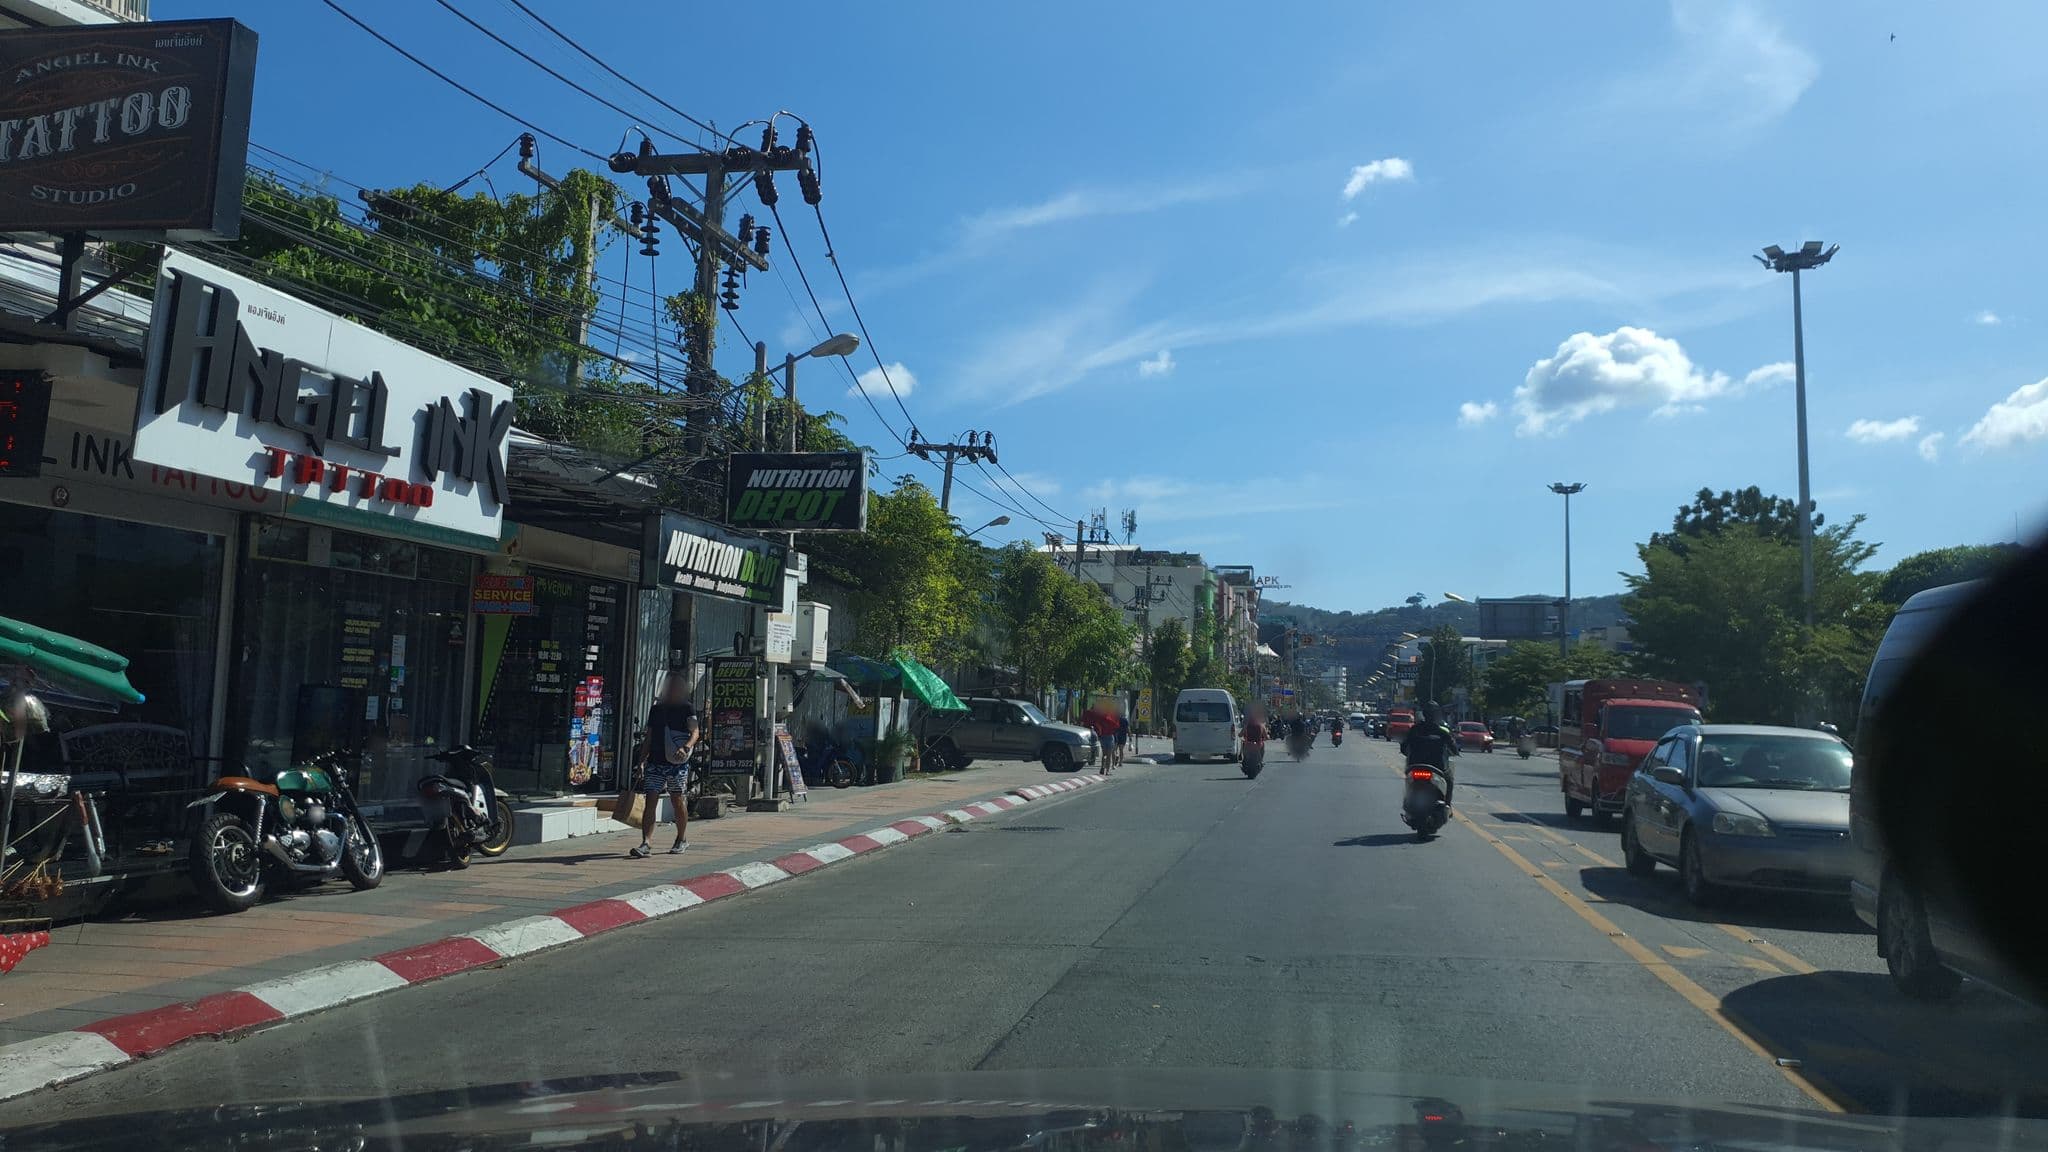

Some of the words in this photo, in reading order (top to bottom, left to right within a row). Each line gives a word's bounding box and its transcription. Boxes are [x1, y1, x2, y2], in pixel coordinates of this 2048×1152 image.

[15, 52, 109, 84] ANGEL
[117, 53, 161, 73] INK
[0, 86, 192, 162] TATTOO
[31, 182, 136, 205] STUDIO
[155, 266, 401, 457] ANGEL
[424, 387, 515, 505] INK
[71, 431, 134, 480] INK
[263, 445, 434, 508] TATTOO
[747, 469, 856, 488] NUTRITION
[733, 489, 846, 521] DEPOT
[664, 529, 744, 580] NUTRITION
[1256, 576, 1280, 585] APK
[474, 589, 531, 601] SERVICE
[715, 667, 751, 678] DEPOT
[714, 683, 755, 696] OPEN
[714, 698, 721, 708] 7
[724, 697, 754, 708] DAYS
